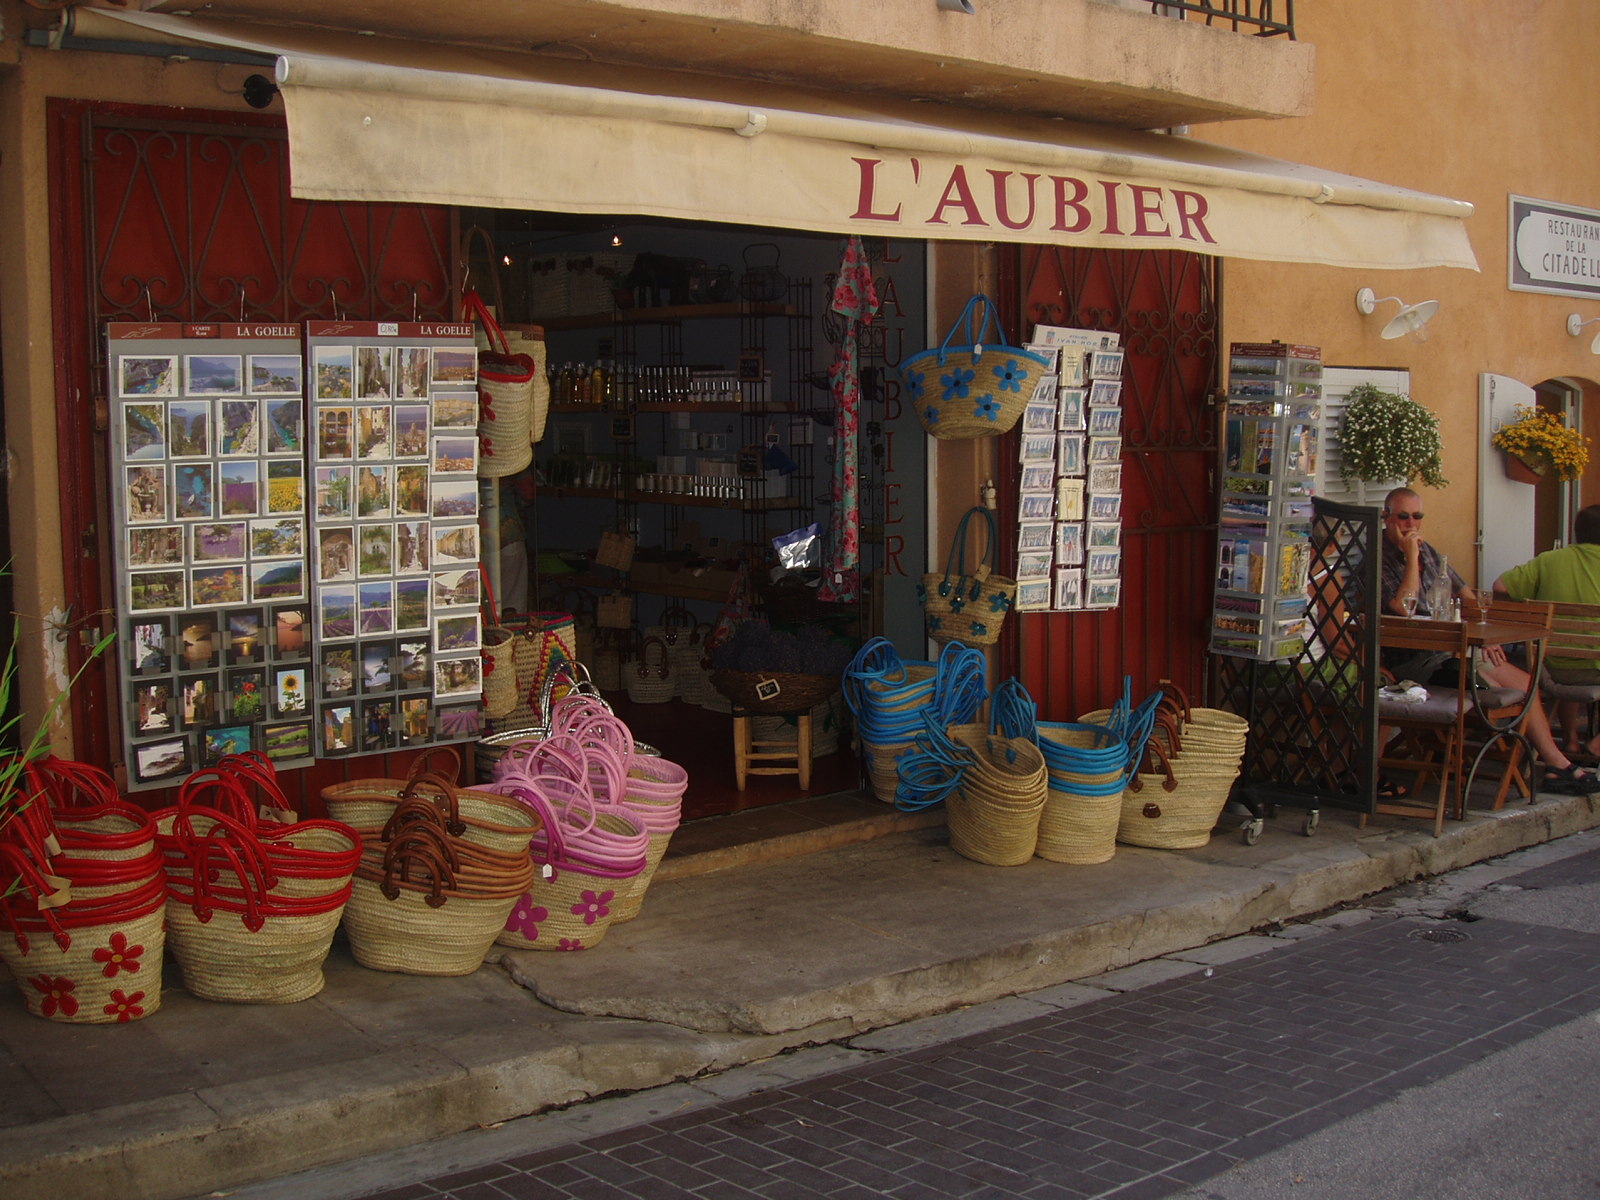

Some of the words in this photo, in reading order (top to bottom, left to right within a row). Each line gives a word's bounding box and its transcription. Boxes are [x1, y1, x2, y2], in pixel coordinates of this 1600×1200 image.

[849, 157, 1220, 246] L'AUBIER
[1566, 240, 1574, 252] DE
[1577, 241, 1586, 254] LA
[237, 326, 251, 336] LA
[255, 326, 296, 337] GOELLE
[420, 325, 432, 335] LA
[436, 326, 471, 335] GOELLE
